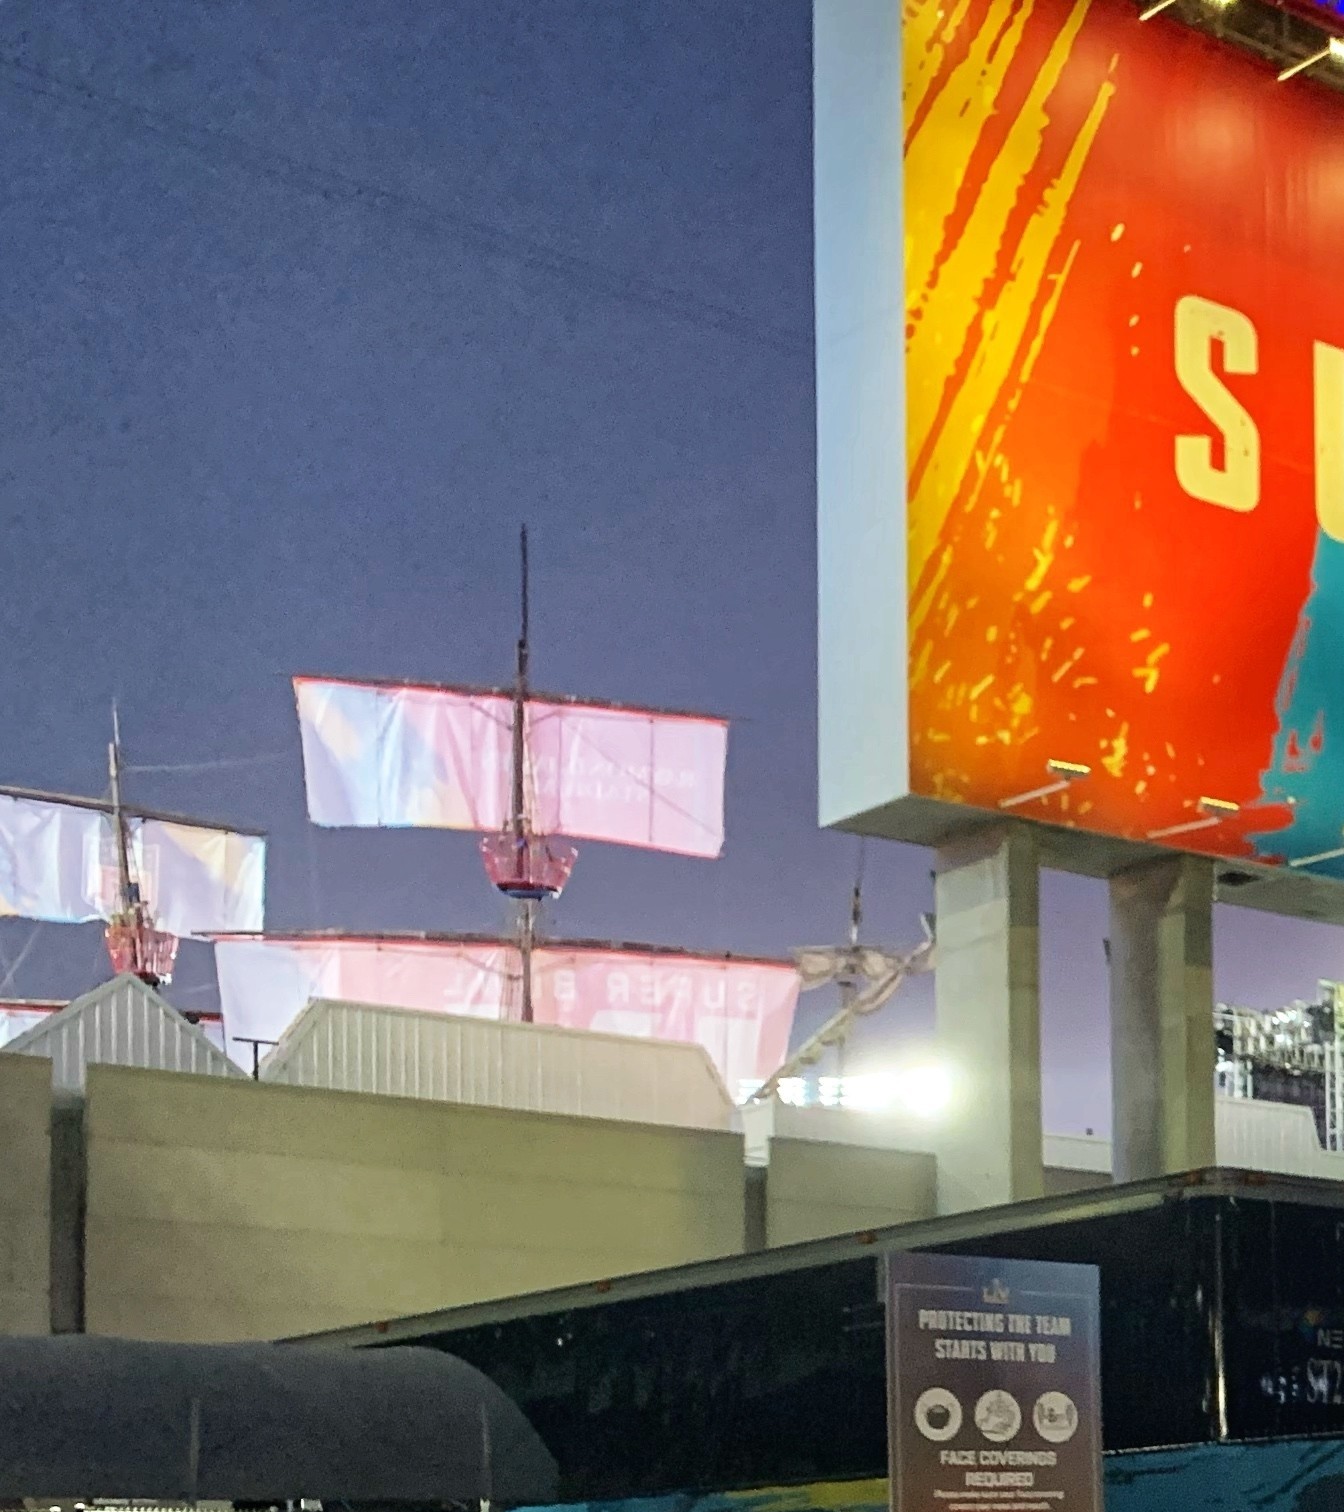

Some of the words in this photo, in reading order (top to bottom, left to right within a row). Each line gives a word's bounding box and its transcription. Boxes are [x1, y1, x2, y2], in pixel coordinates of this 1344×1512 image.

[918, 1309, 1004, 1333] PROTECTING
[1008, 1313, 1032, 1334] THE
[1035, 1315, 1071, 1336] TEAM
[934, 1338, 987, 1360] STARTS
[989, 1341, 1025, 1362] WITH
[1028, 1342, 1057, 1363] YOU
[940, 1449, 977, 1465] FACE
[979, 1449, 1057, 1466] COVERINGS
[965, 1471, 1034, 1487] REQUIRED
